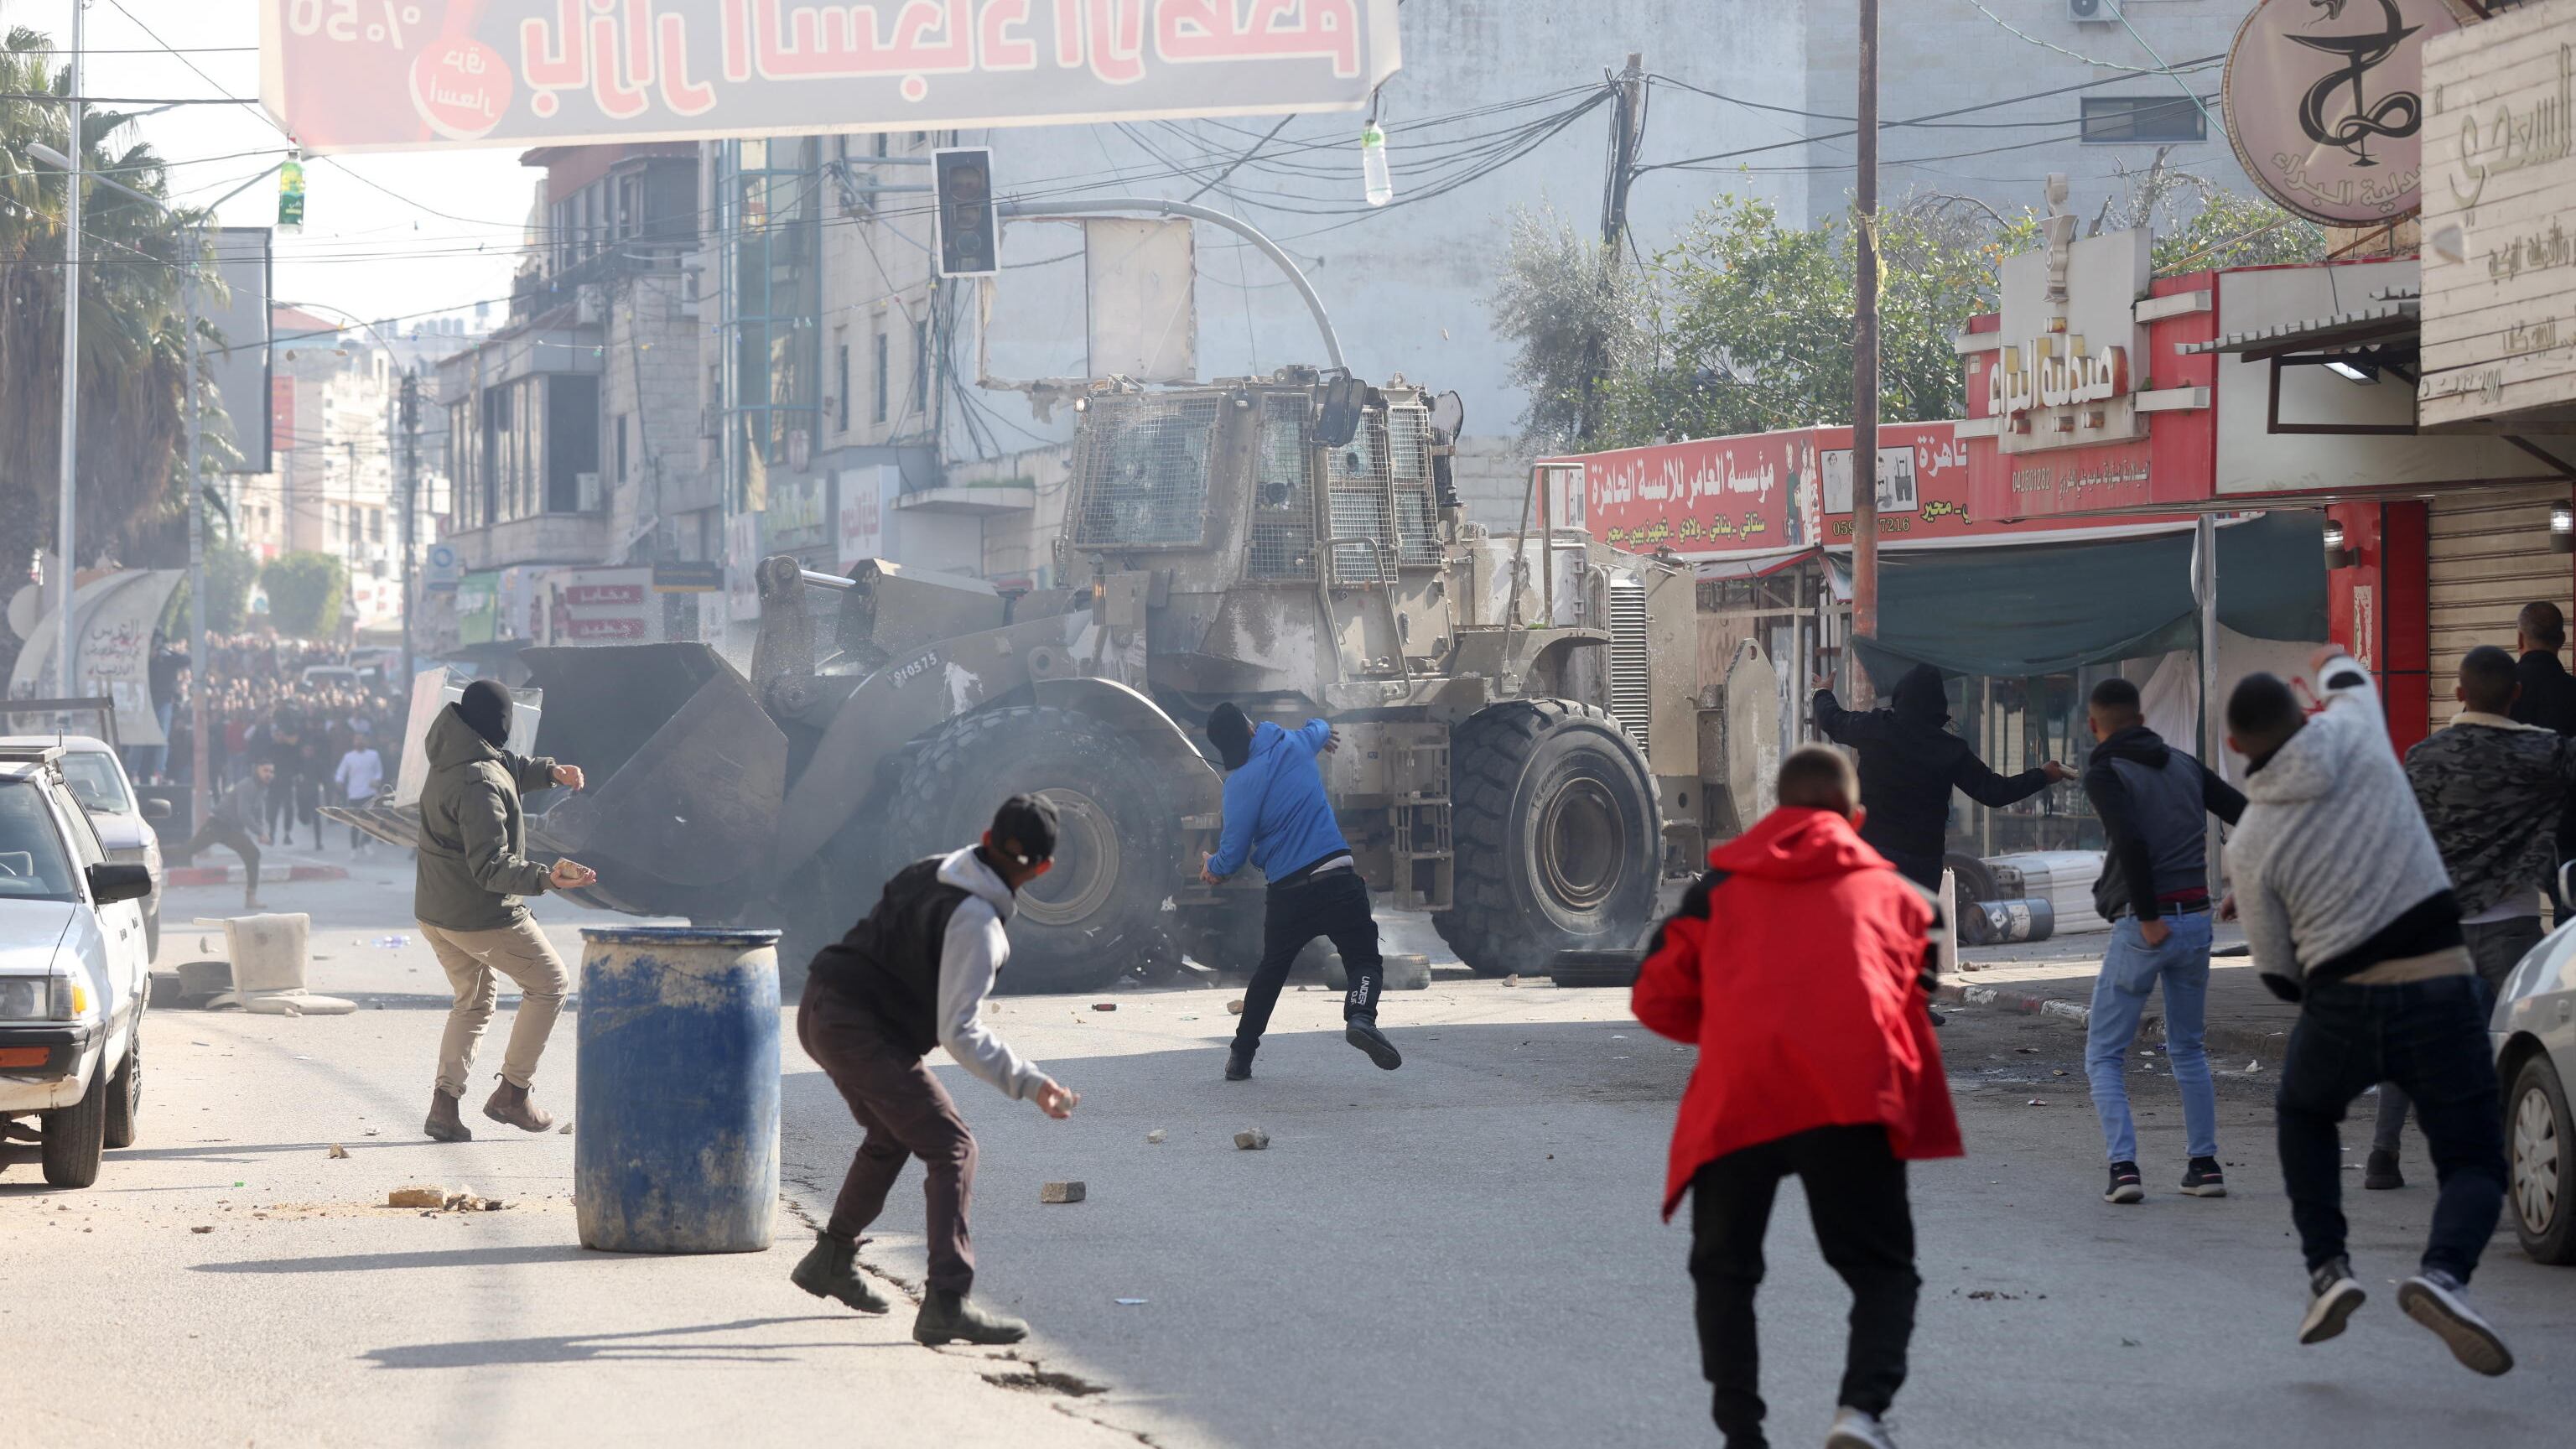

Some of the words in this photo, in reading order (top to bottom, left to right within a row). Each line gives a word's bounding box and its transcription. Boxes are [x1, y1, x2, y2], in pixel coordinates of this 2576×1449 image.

[2271, 152, 2354, 207] البراء
[2360, 163, 2421, 214] دلية
[1687, 453, 1725, 510] العامر
[1726, 449, 1774, 504] مؤسسة
[1917, 435, 1967, 477] اهزة
[1592, 461, 1635, 517] الجاهزة
[1832, 517, 1910, 537] 0597216
[1358, 976, 1370, 1005] UNDER
